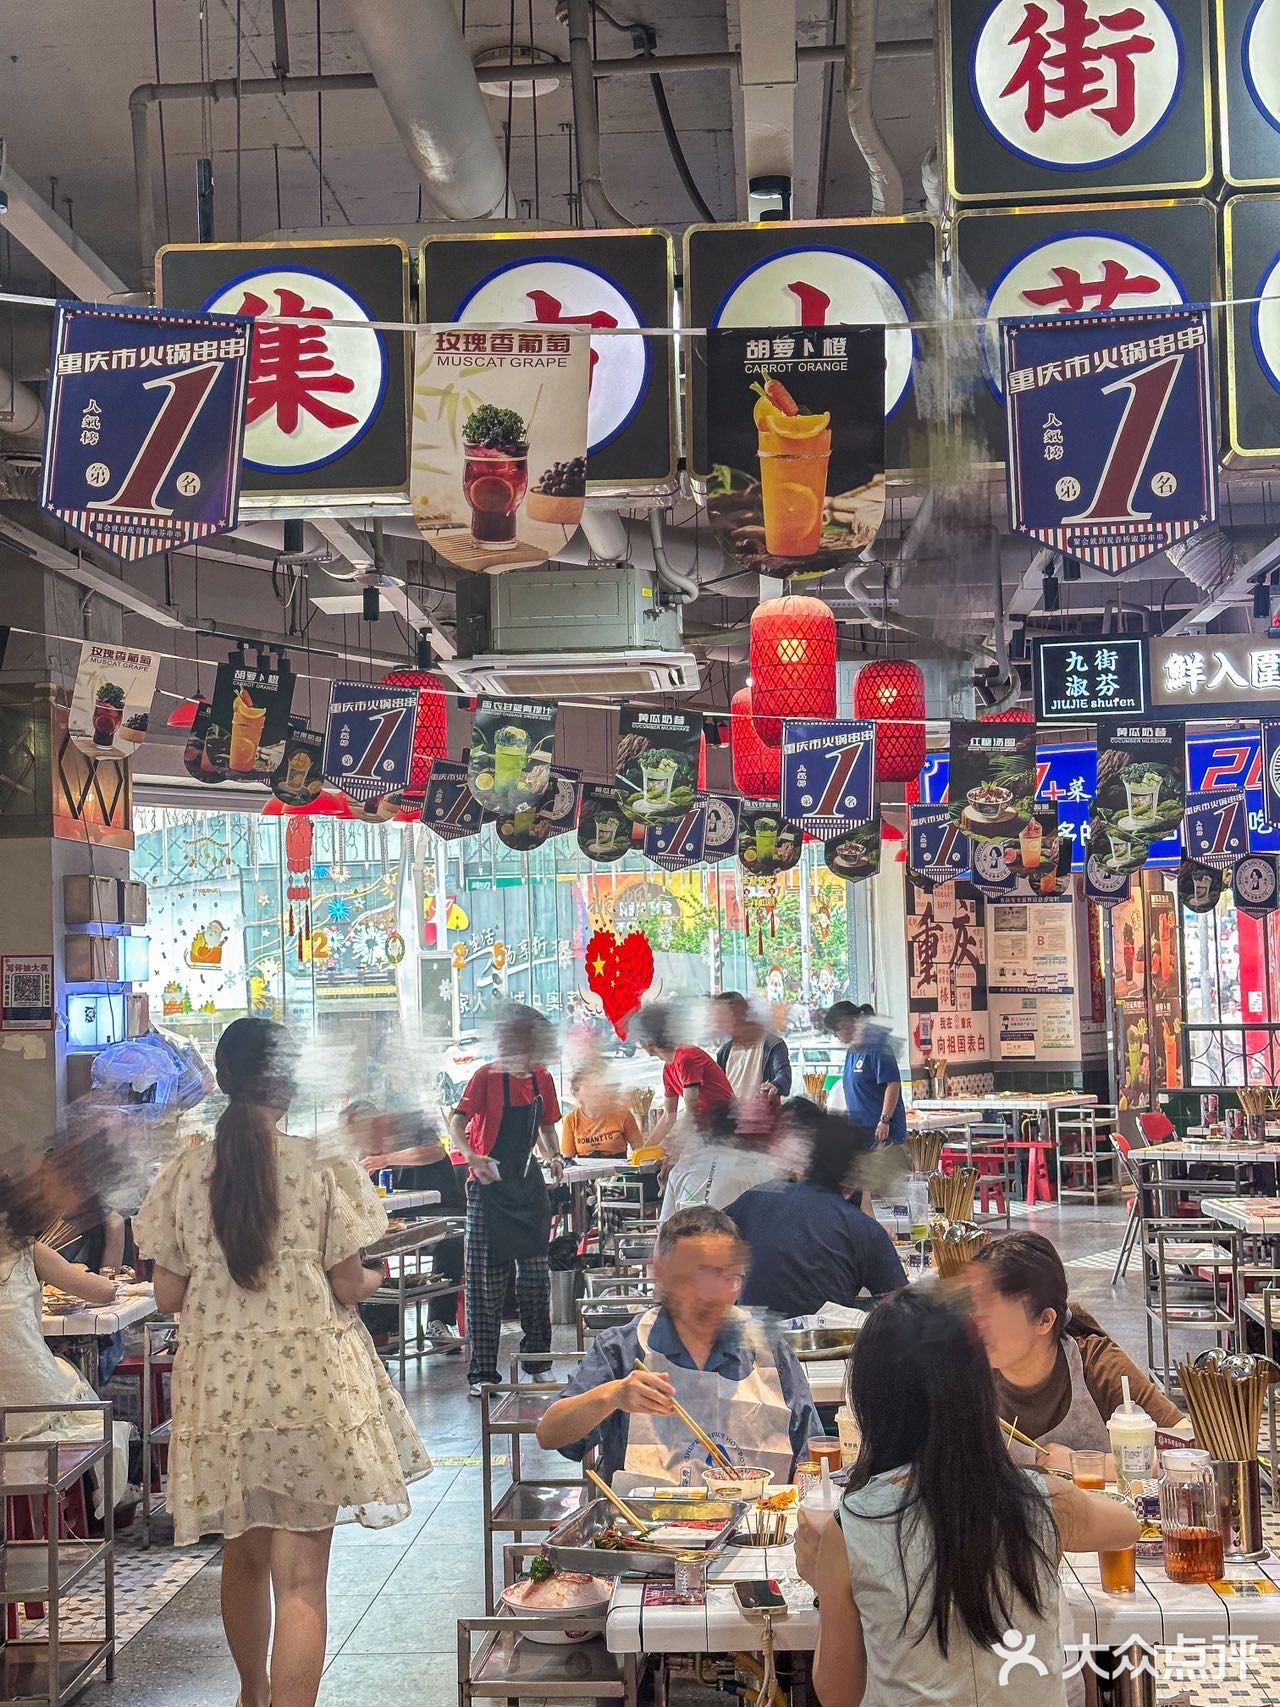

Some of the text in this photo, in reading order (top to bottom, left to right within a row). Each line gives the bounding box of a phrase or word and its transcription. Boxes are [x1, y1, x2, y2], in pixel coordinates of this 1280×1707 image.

[999, 0, 1155, 137] 街
[436, 332, 571, 353] 玫瑰香葡萄
[746, 337, 847, 359] 胡萝卜橙
[57, 337, 246, 376] 重庆市火锅串串
[236, 288, 358, 434] 集
[437, 356, 567, 368] MUSCAT GRAPE
[1009, 326, 1206, 394] 重庆市火锅串串
[745, 361, 848, 374] CARROT ORANGE
[86, 361, 225, 516] 1
[181, 475, 198, 494] 名
[1061, 353, 1185, 524] 1
[1155, 475, 1173, 495] 名
[90, 656, 150, 672] MUSCAT GRAPE
[91, 646, 152, 665] 玫瑰香葡萄
[1065, 648, 1119, 672] 九街
[233, 680, 278, 691] CARROT ORANGE
[1065, 673, 1120, 698] 淑芬
[329, 697, 417, 714] 重庆市火锅串串
[1051, 697, 1136, 710] JIUJIE shufen
[638, 713, 685, 725] 黄瓜奶昔
[1116, 727, 1167, 737] 黄瓜奶昔
[783, 730, 874, 755] 重庆市火锅串串
[1037, 936, 1045, 946] B
[937, 1034, 986, 1054] 向祖国表白
[577, 1133, 614, 1145] ROMANTIC
